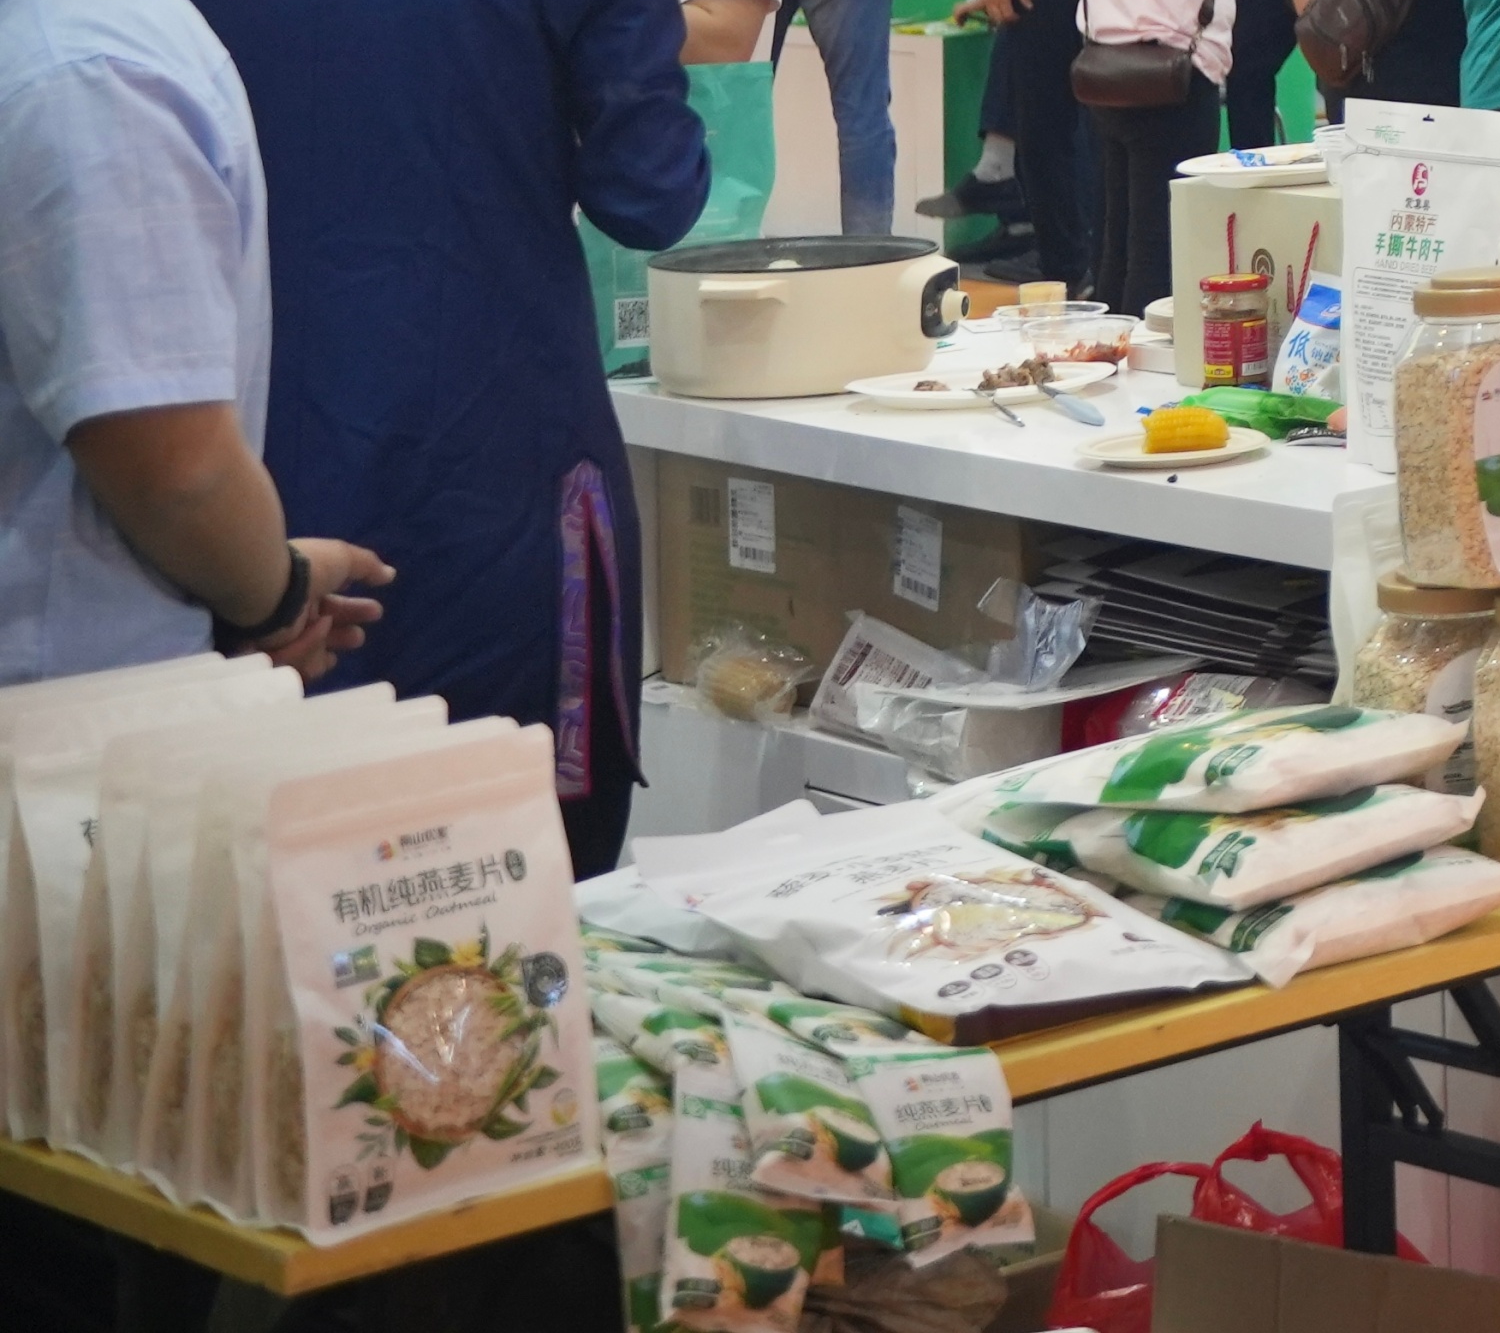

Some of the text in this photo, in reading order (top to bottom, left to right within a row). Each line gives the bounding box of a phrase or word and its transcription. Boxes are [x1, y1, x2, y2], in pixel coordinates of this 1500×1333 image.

[1374, 232, 1445, 264] 手撕牛肉干
[331, 852, 504, 923] 有机纯燕麦片
[426, 893, 497, 919] Oatmeal
